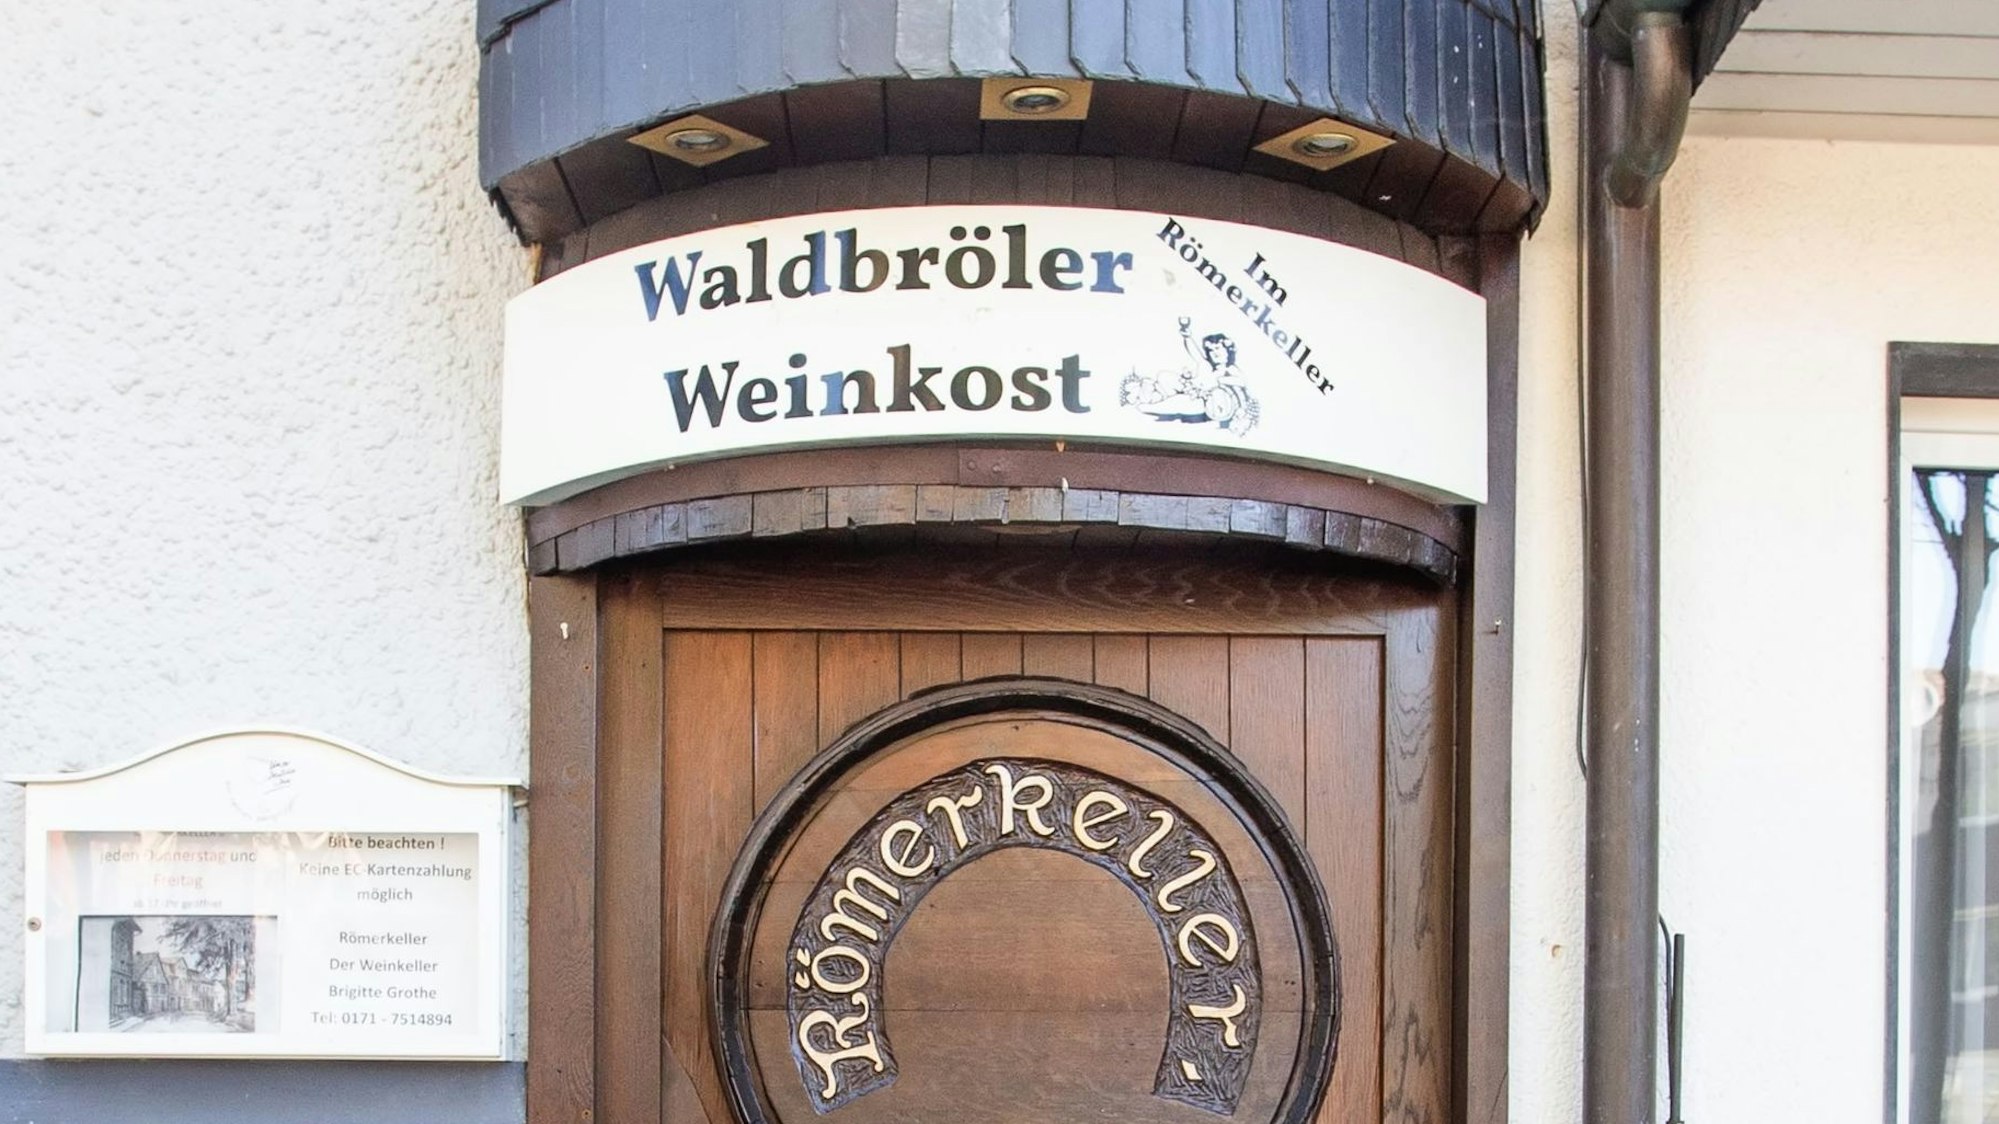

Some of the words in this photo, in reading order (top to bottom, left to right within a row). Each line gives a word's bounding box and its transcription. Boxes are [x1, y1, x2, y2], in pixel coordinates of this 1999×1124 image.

[635, 224, 1133, 322] Waldbröler
[1243, 251, 1289, 307] Im
[1156, 216, 1335, 396] Römerkeller
[664, 344, 1092, 434] Weinkost
[328, 836, 363, 849] Bitte
[367, 836, 436, 850] beachten
[440, 837, 446, 850] !
[143, 849, 226, 866] Dnnerstag
[230, 849, 257, 863] und
[299, 863, 340, 877] Keine
[153, 873, 204, 889] Freitag
[356, 887, 414, 903] möglich
[339, 931, 428, 946] Römerkeller
[329, 958, 356, 971] Der
[359, 958, 439, 973] Weinkeller
[328, 985, 383, 1001] Brigitte
[386, 986, 438, 1000] Grothe
[311, 1011, 338, 1026] Tel:
[341, 1012, 377, 1025] 0171
[391, 1012, 453, 1027] 7514894
